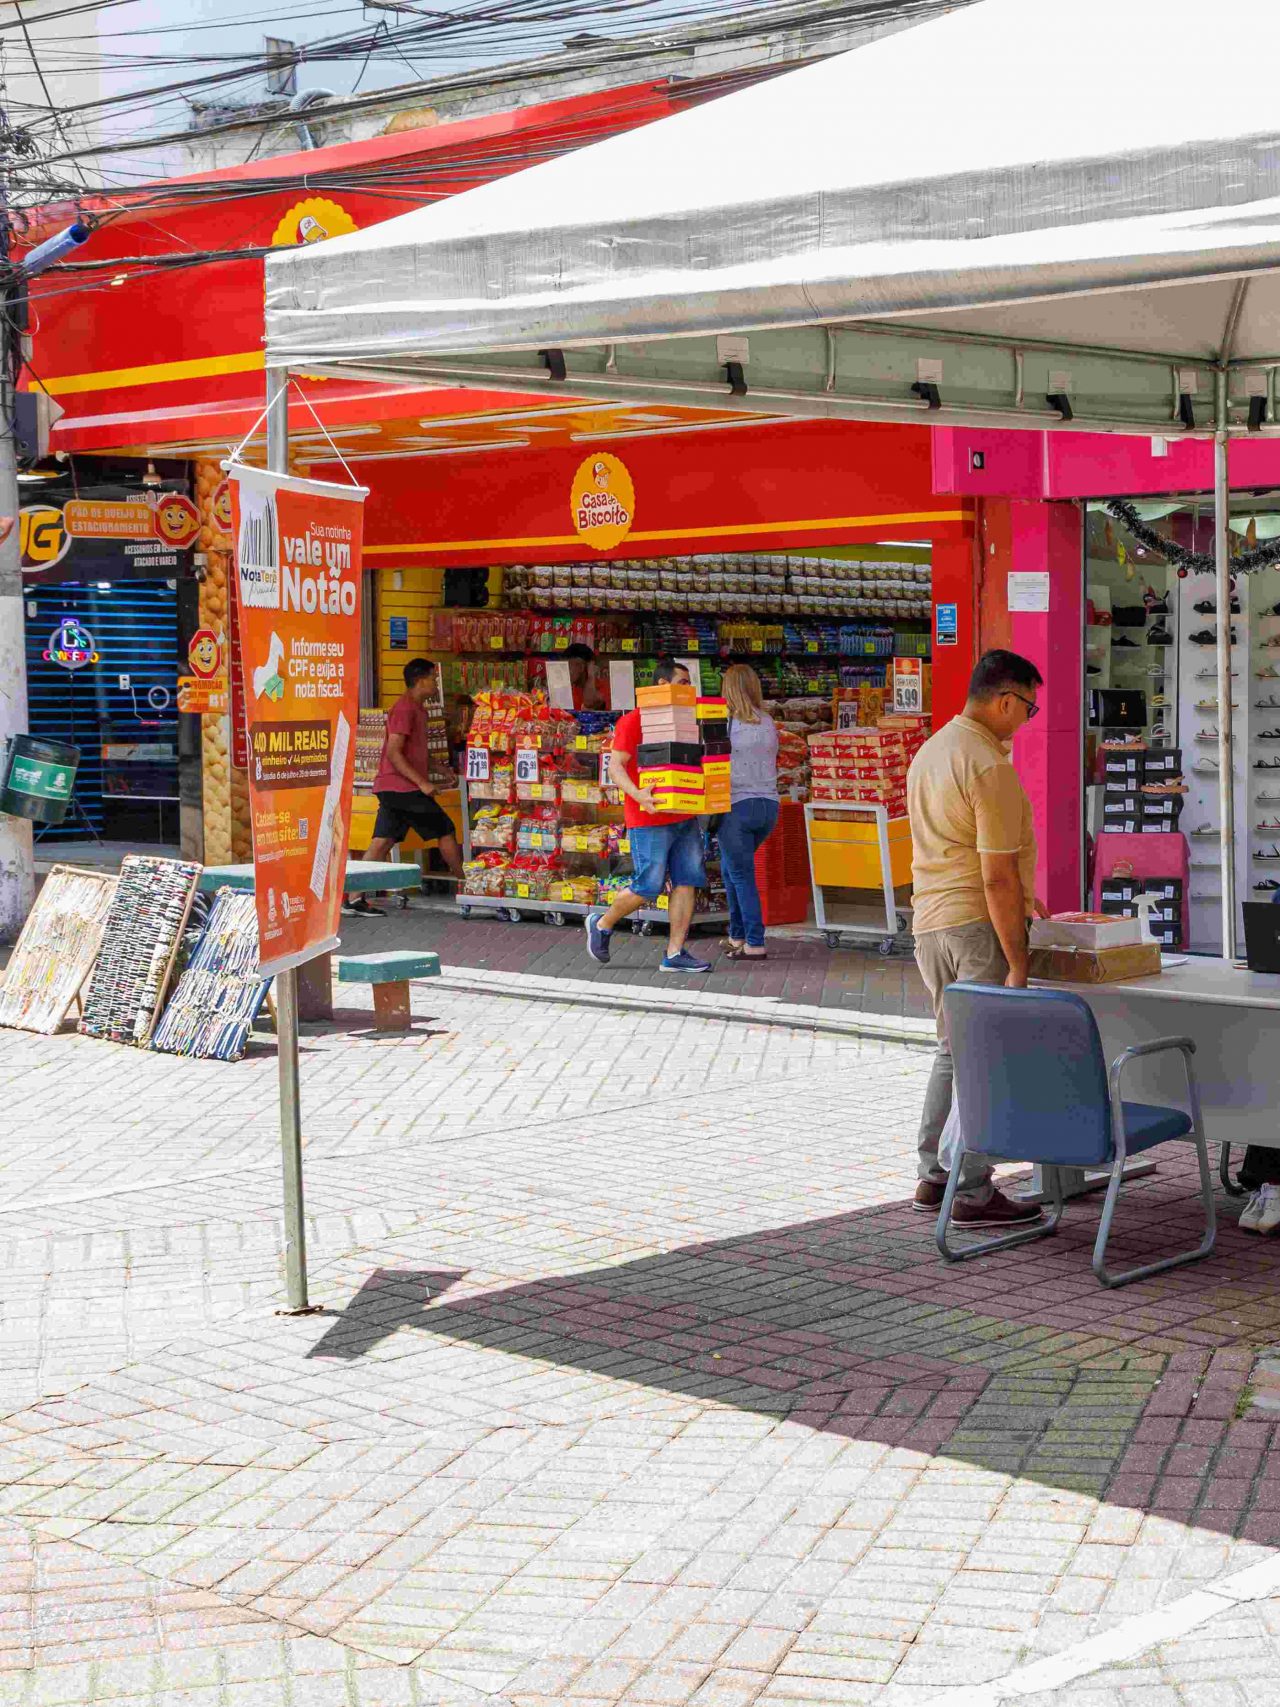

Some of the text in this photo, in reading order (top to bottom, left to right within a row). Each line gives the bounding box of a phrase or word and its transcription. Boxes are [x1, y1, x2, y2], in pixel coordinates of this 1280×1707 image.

[582, 493, 607, 508] Casa
[578, 505, 628, 529] Biscoito
[72, 522, 149, 533] ESTACIONAMENTO
[311, 522, 351, 539] Sua notinha
[283, 531, 351, 569] vale um
[282, 567, 356, 616] Notão
[291, 637, 344, 657] Informe seu
[288, 659, 344, 680] CPF e exija a
[295, 681, 316, 699] nota
[269, 731, 293, 752] MIL
[294, 730, 329, 751] REAIS
[469, 750, 476, 760] 3
[642, 776, 666, 785] moleca
